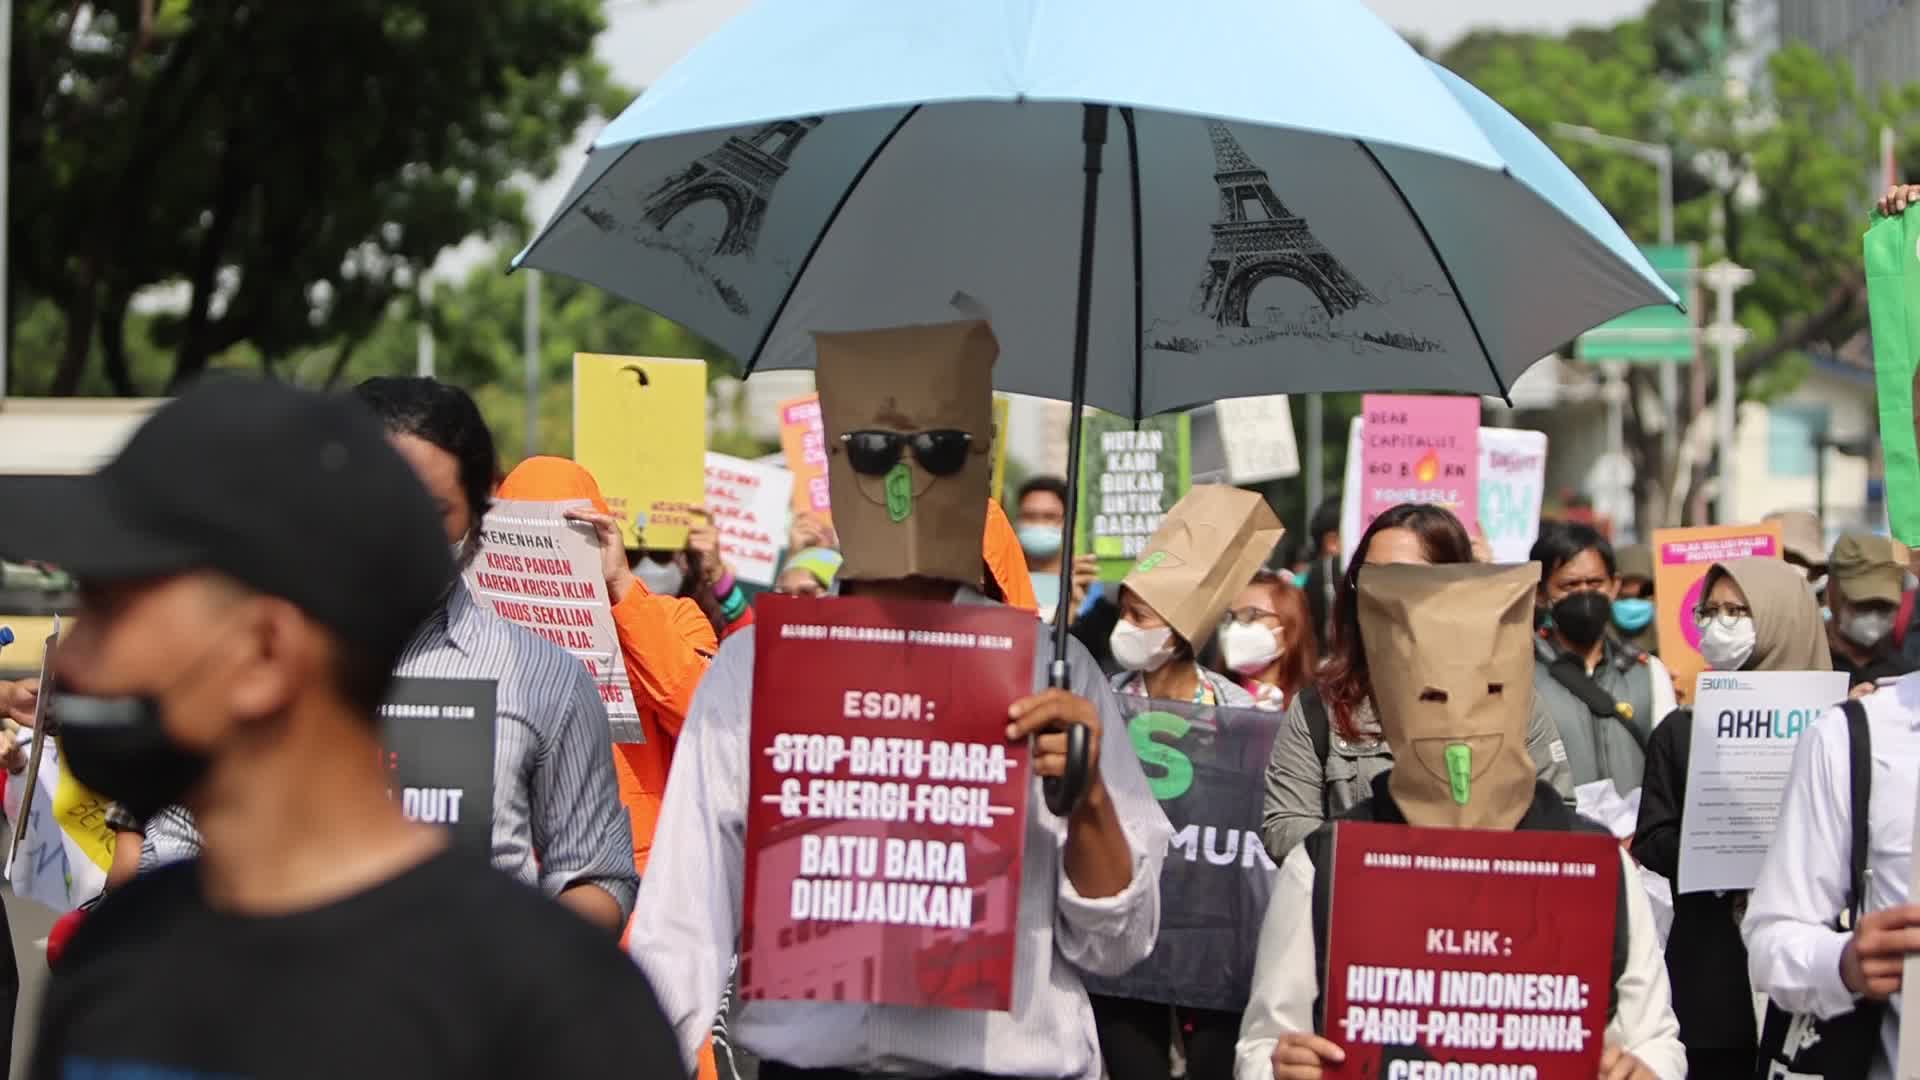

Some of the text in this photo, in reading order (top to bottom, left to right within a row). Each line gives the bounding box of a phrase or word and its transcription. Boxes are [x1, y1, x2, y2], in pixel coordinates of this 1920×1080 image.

[1102, 431, 1162, 451] HUTAN
[1107, 453, 1156, 471] KAMI
[1101, 472, 1164, 493] BUKAN
[1102, 494, 1162, 513] UNTUK
[486, 552, 573, 576] KRISIS PANGAN
[476, 571, 596, 599] KARENA KRISIS IKLIM
[532, 605, 594, 627] SEKALIAN
[844, 690, 935, 721] ESDM:
[773, 733, 1007, 783] STOP BATU BARA
[403, 787, 463, 823] DUIT
[780, 778, 994, 827] & ENERGI FOSIL
[800, 834, 968, 883] BATU BARA
[1364, 852, 1596, 878] ALIANSI PERLAWANAN PERUBAHAN IKLIM
[790, 879, 973, 928] DIHIJAUKAN
[1426, 928, 1513, 956] KLHK:
[1346, 965, 1590, 1011] HUTAN INDONESIA:
[1502, 1014, 1584, 1052] DUNIA
